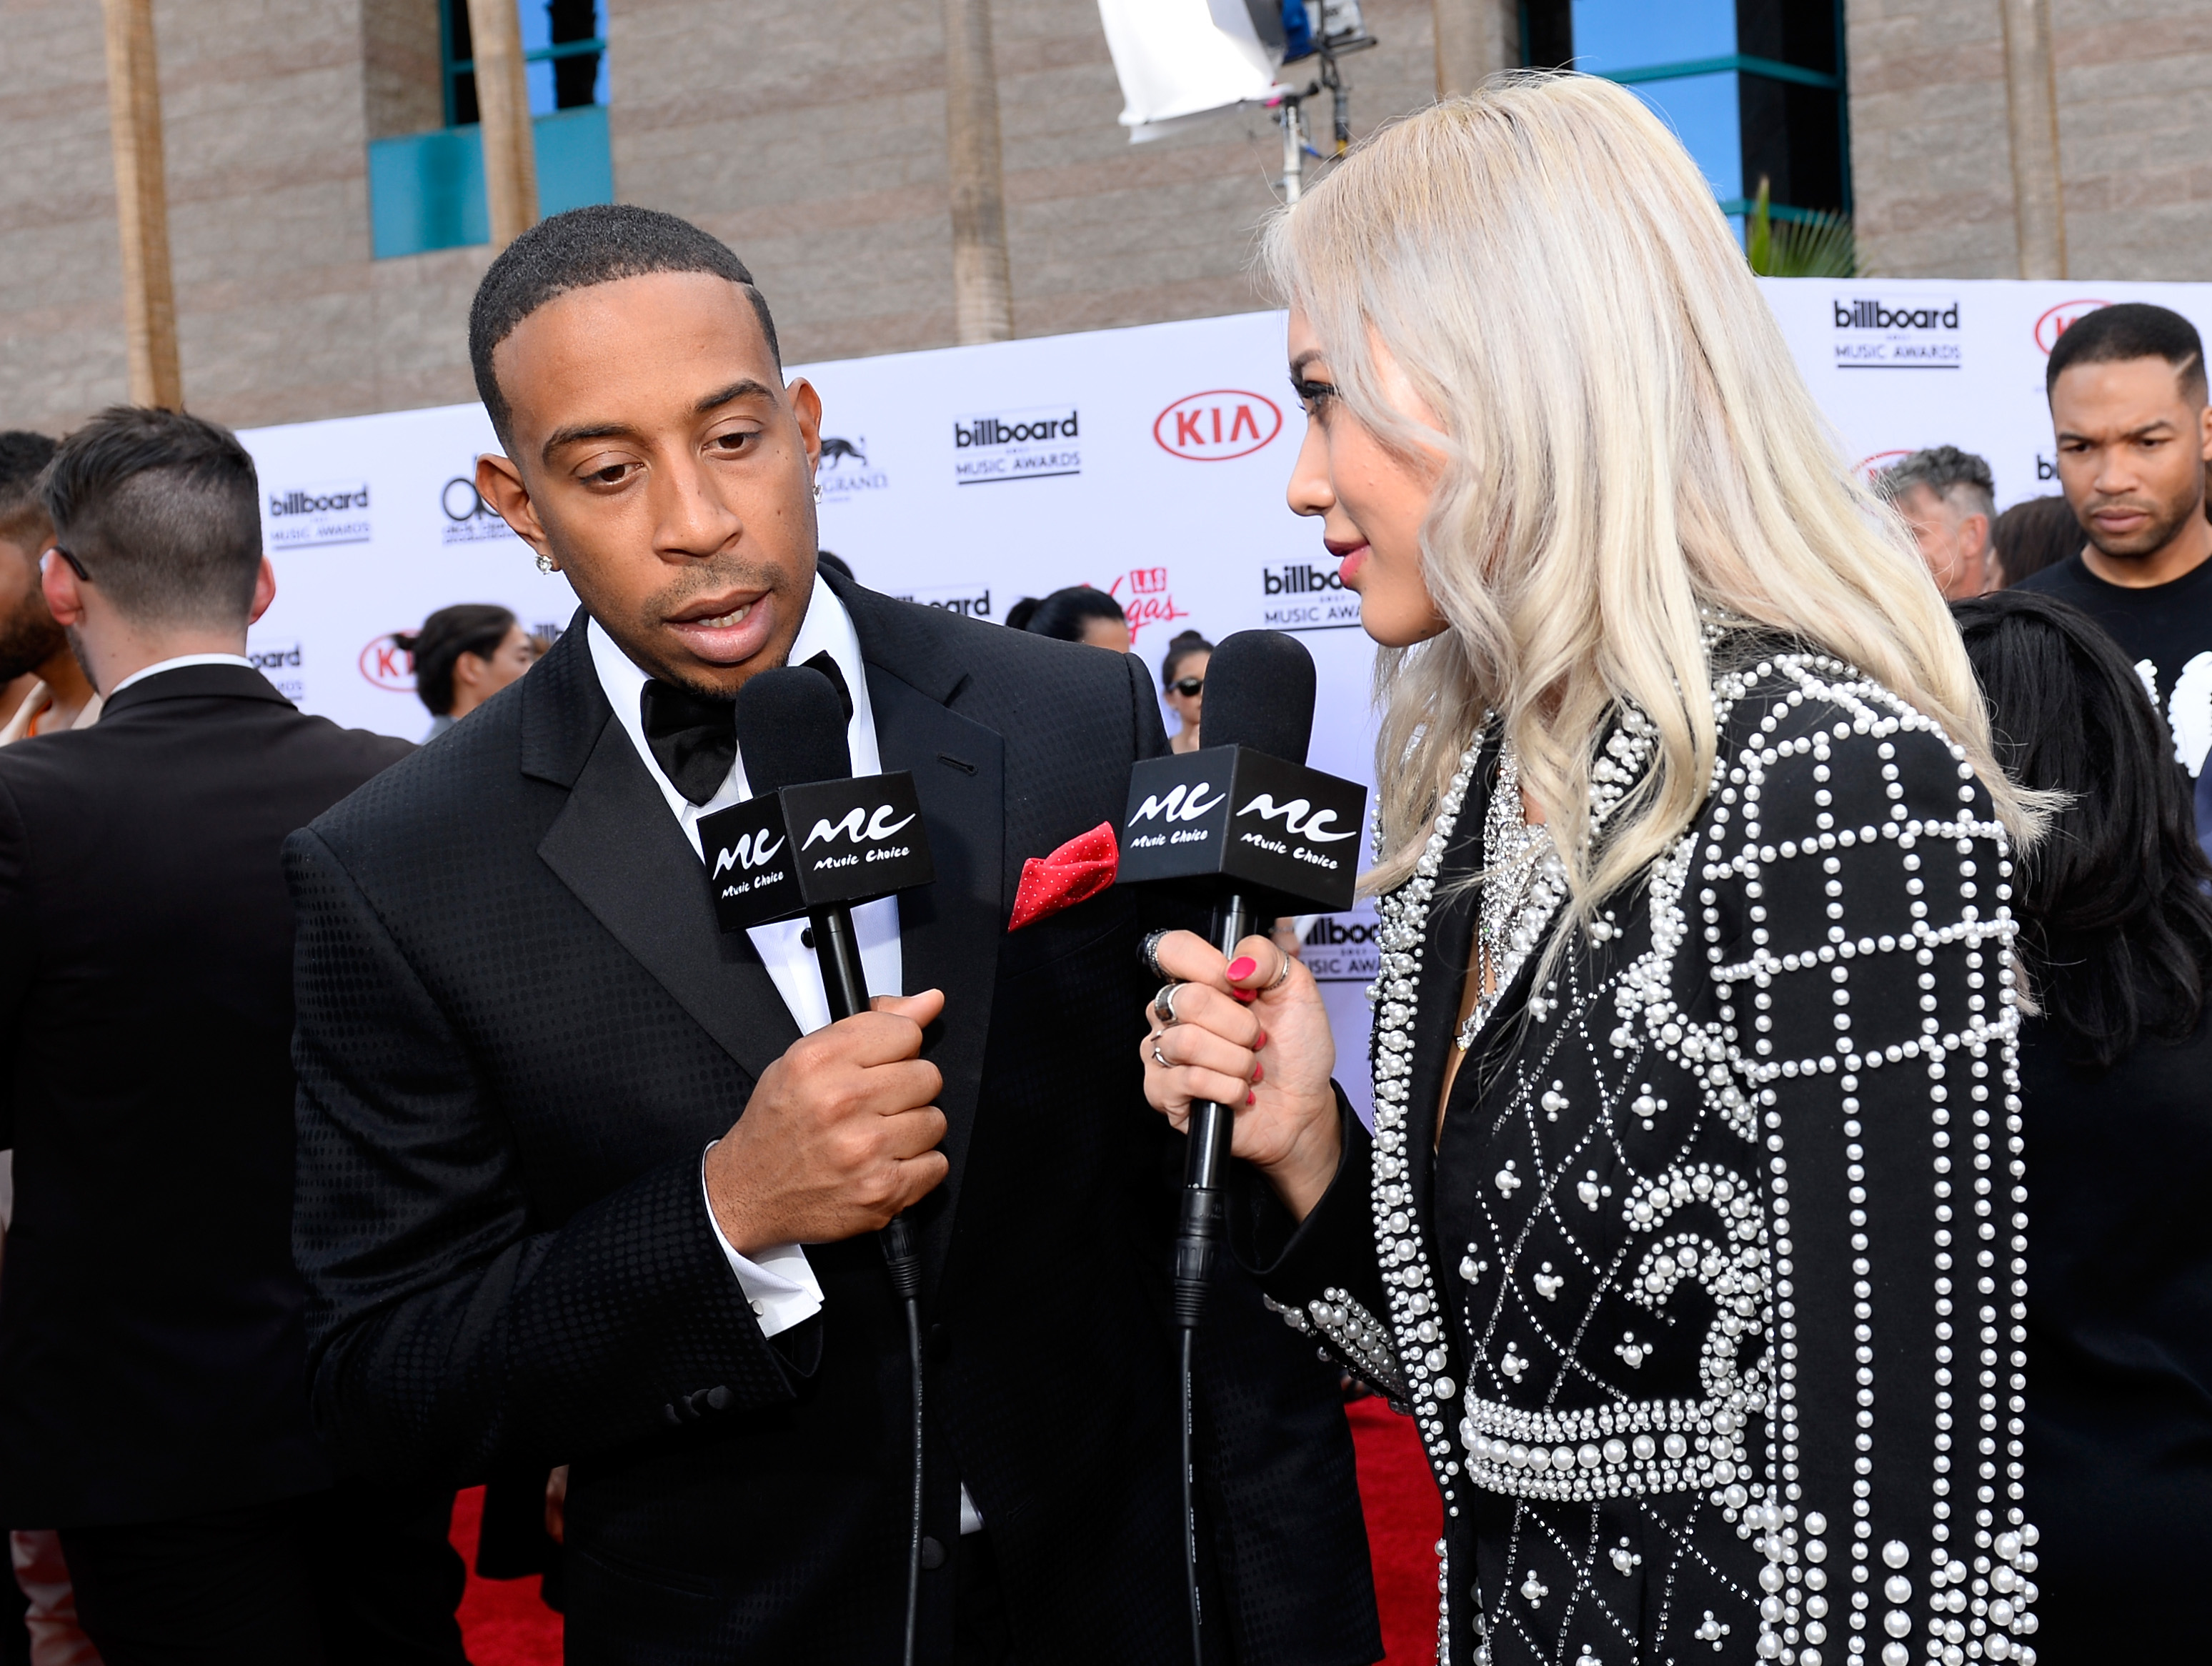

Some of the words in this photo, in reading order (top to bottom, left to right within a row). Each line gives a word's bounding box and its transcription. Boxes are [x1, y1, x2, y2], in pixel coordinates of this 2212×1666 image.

[1834, 300, 1958, 329] billboard
[1835, 345, 1885, 358] MUSIC
[1894, 344, 1961, 359] AWARDS
[955, 411, 1077, 447] billboard
[1176, 405, 1260, 447] KIA
[956, 458, 1005, 474] MUSIC
[1012, 452, 1080, 469] AWARDS
[270, 484, 368, 516] billboard
[271, 527, 309, 540] MUSIC
[317, 522, 369, 536] AWARDS
[1264, 564, 1342, 594] billbo
[1265, 607, 1319, 622] MUSIC
[378, 649, 414, 677] KI
[1127, 782, 1226, 828] MC
[1236, 793, 1357, 842] MC
[802, 804, 916, 852] MC
[1130, 832, 1166, 848] Music
[1170, 829, 1208, 844] Choice
[713, 828, 785, 880] MC
[814, 854, 860, 872] Music
[865, 846, 910, 862] Choice
[1240, 832, 1287, 854] Music
[1292, 847, 1338, 869] Choice
[722, 882, 751, 899] Music
[754, 871, 784, 889] Choice
